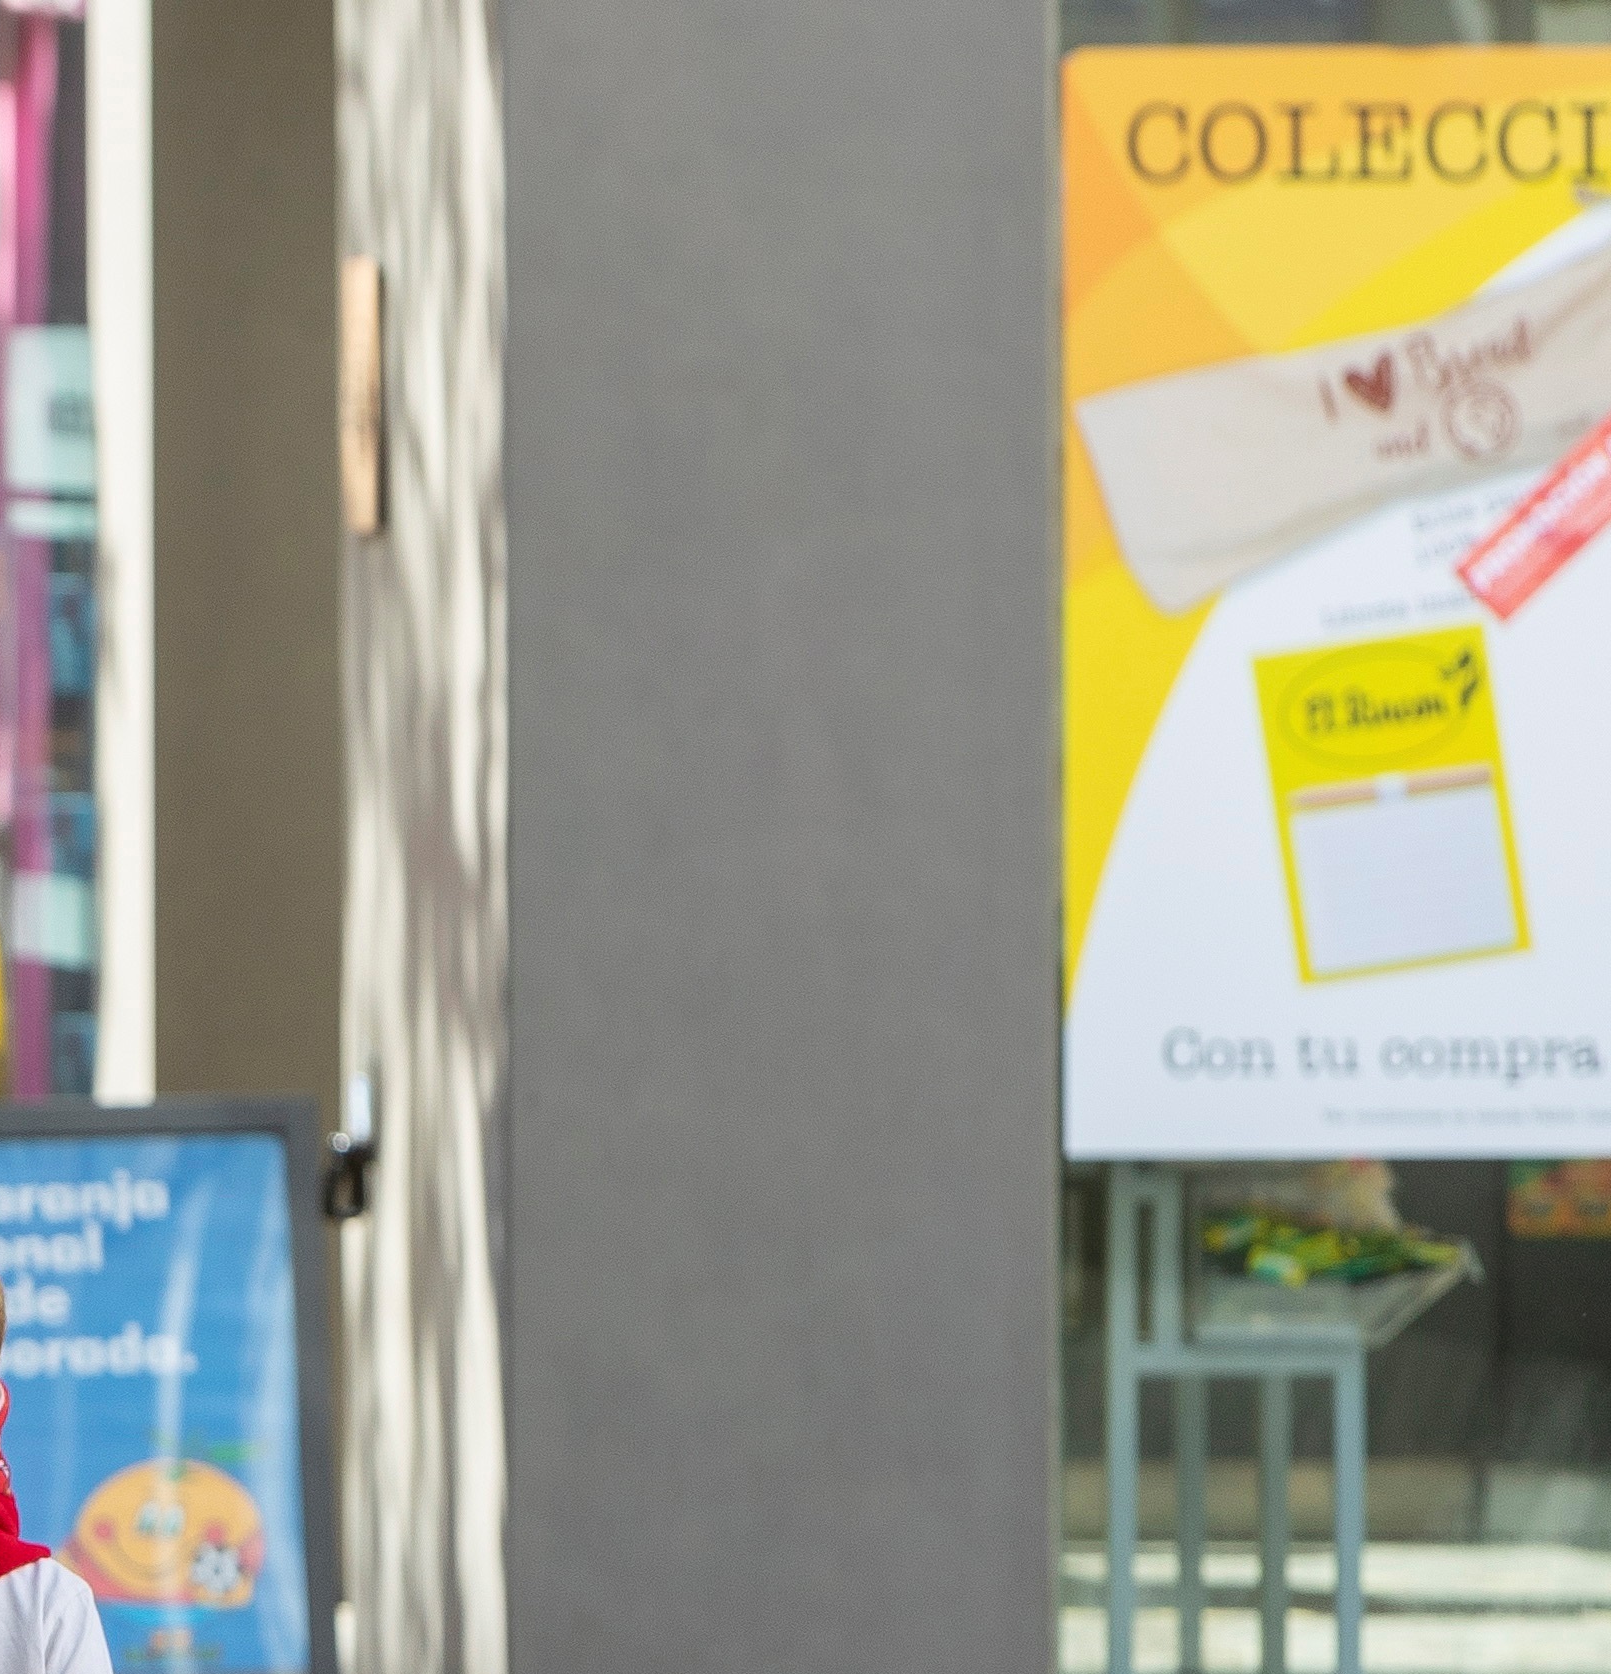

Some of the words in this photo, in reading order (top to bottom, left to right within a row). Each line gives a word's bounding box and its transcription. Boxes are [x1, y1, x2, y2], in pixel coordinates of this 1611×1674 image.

[1161, 1026, 1276, 1080] Con
[1297, 1031, 1360, 1080] tu
[1380, 1035, 1602, 1090] compra
[1, 1322, 200, 1377] orada.
